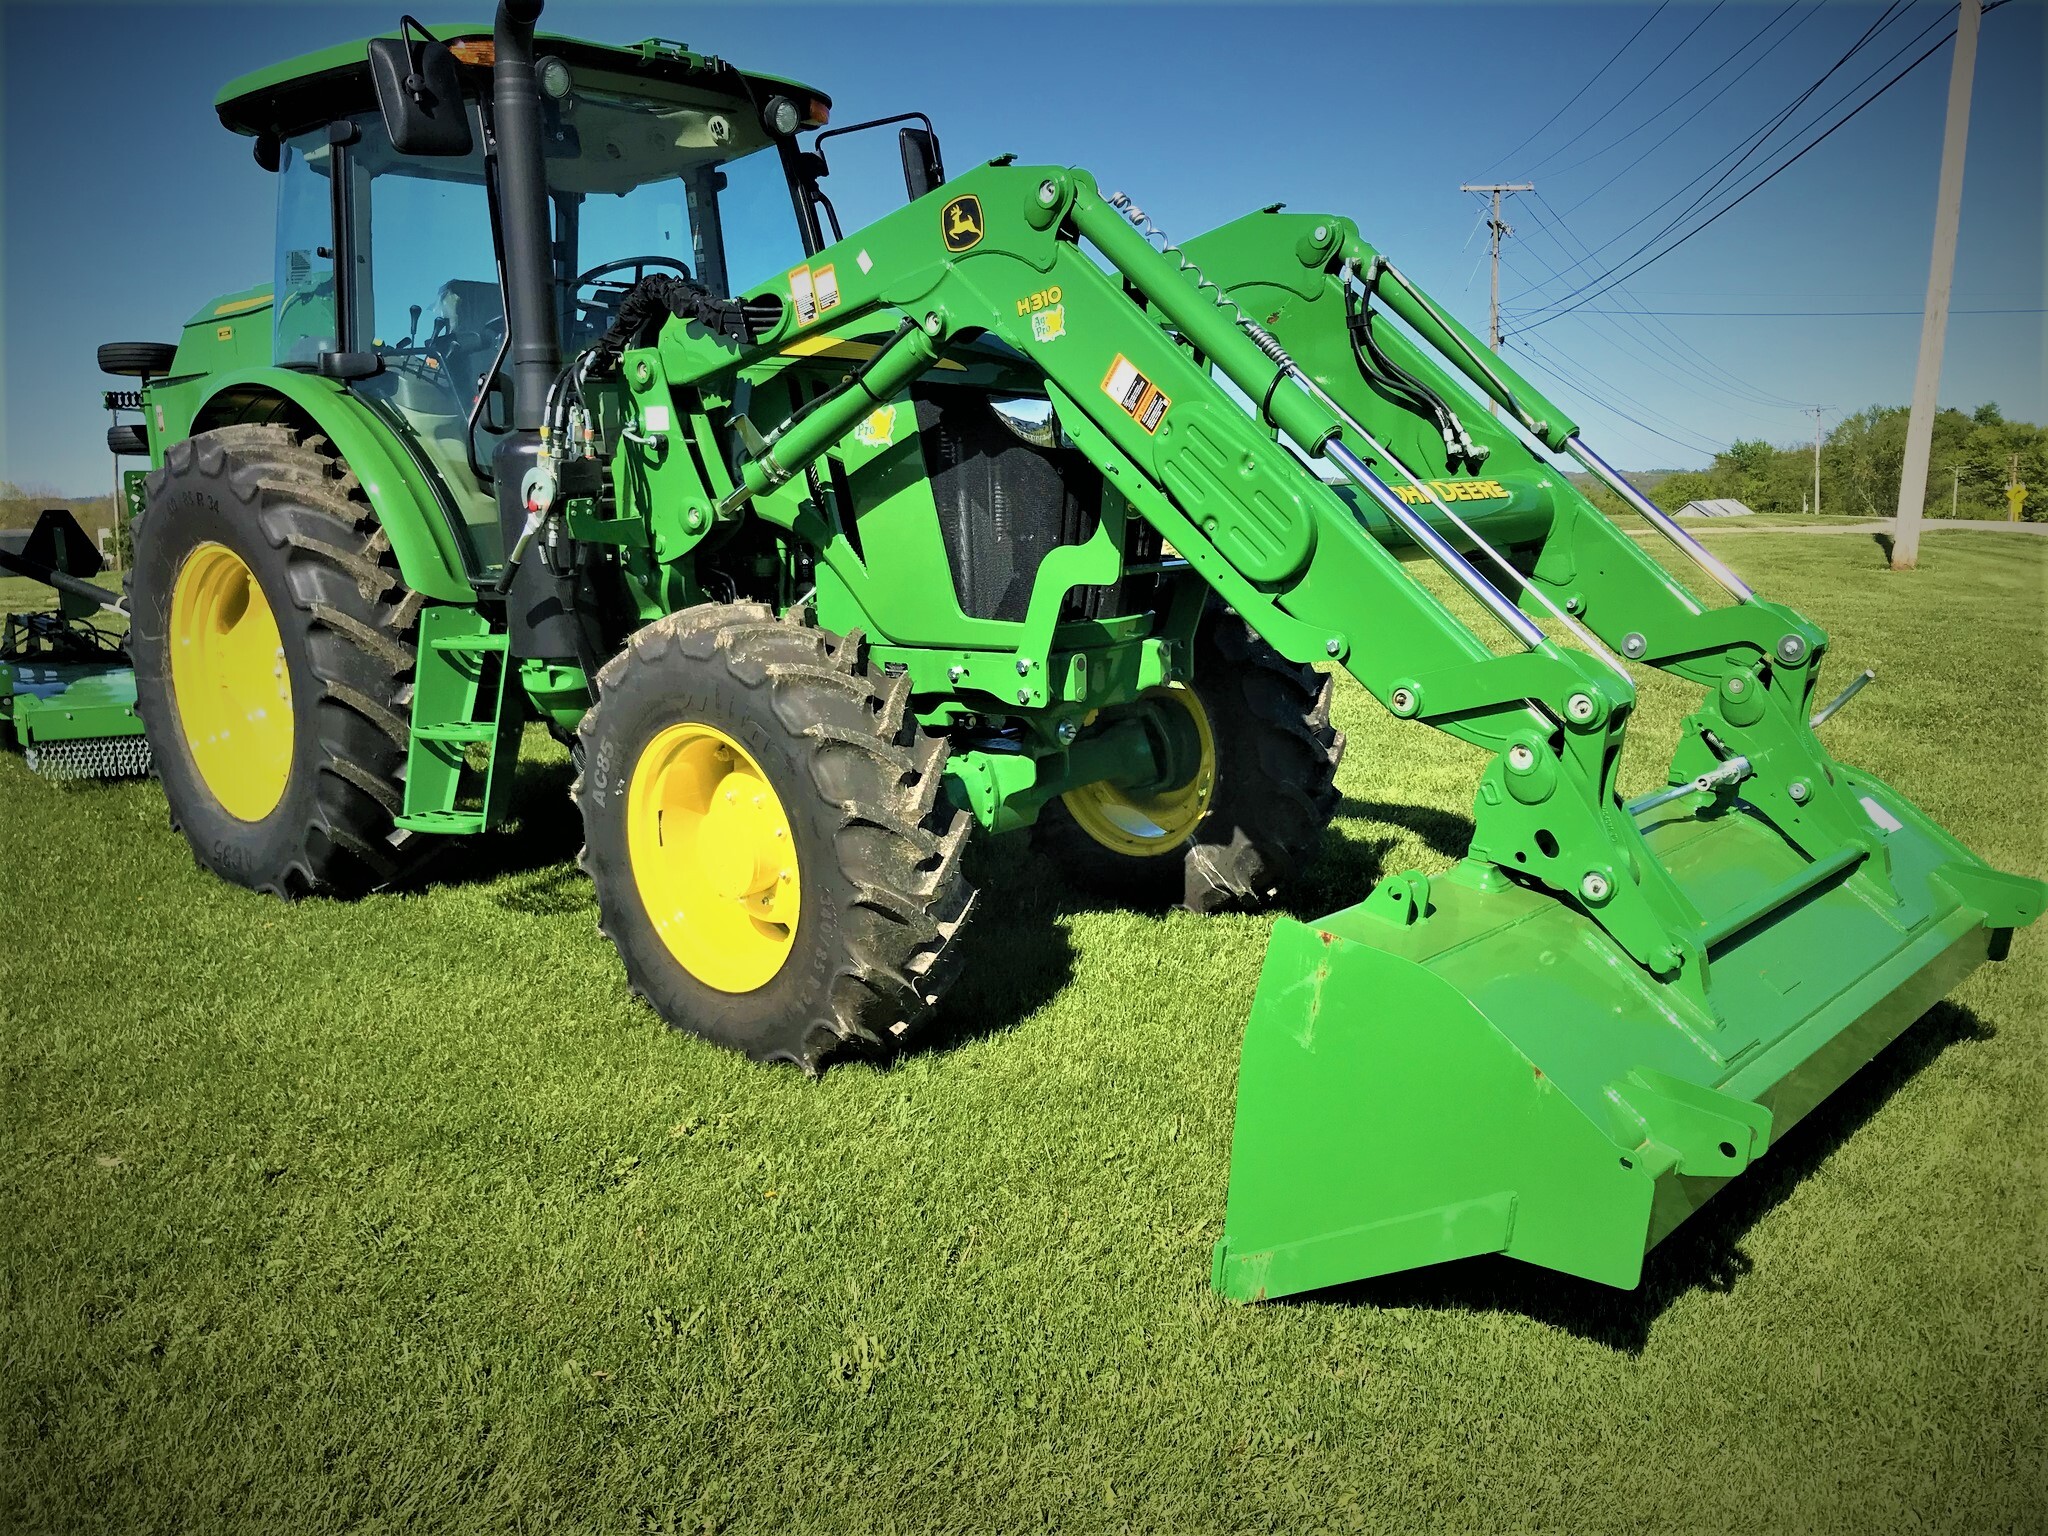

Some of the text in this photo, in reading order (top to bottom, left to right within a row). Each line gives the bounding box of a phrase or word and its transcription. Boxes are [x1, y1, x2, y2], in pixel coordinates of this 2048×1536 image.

[1016, 285, 1062, 317] H310
[1428, 480, 1509, 503] DEERE
[592, 735, 614, 809] AC85
